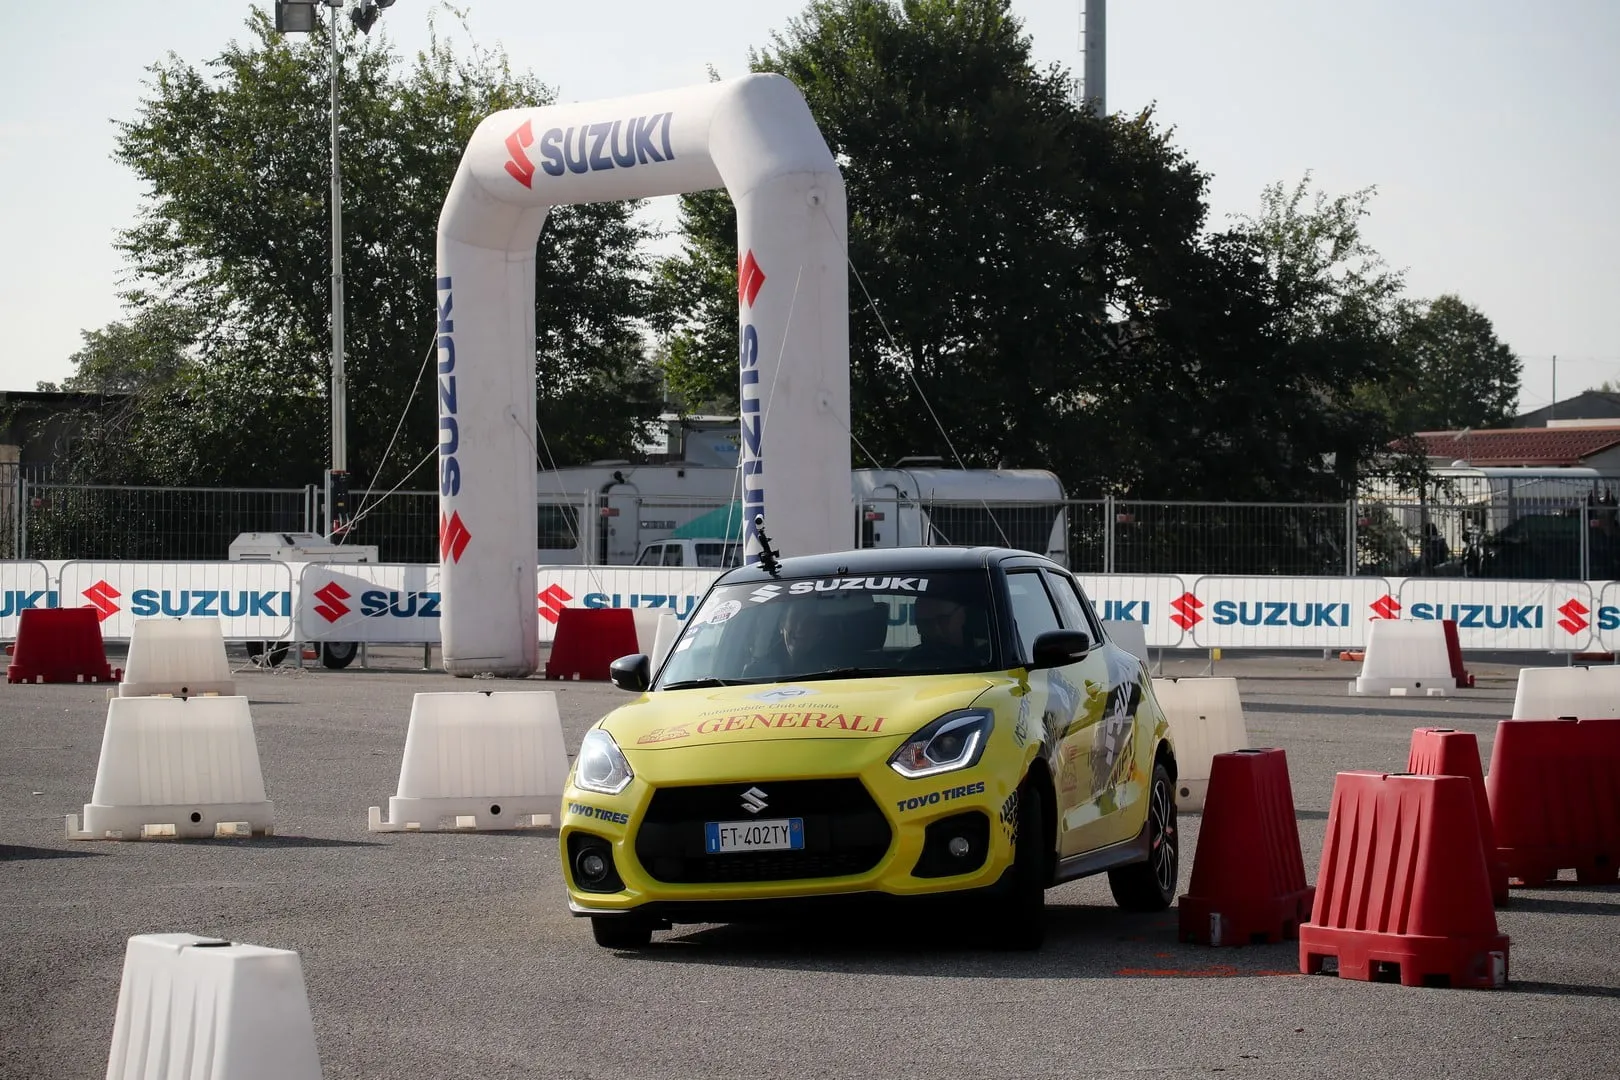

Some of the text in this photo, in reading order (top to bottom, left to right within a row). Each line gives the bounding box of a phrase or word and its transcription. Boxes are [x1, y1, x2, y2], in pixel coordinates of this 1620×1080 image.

[539, 112, 674, 177] SUZUKI
[437, 276, 461, 498] SUZUKI
[788, 577, 928, 595] SUZUKI
[131, 590, 291, 617] SUZUKI
[1212, 600, 1349, 627] SUZUKI
[1410, 603, 1543, 629] SUZUKI
[696, 712, 888, 735] GENERALI
[897, 781, 985, 812] TOYO TIRES
[568, 802, 629, 825] TOYO TIRES
